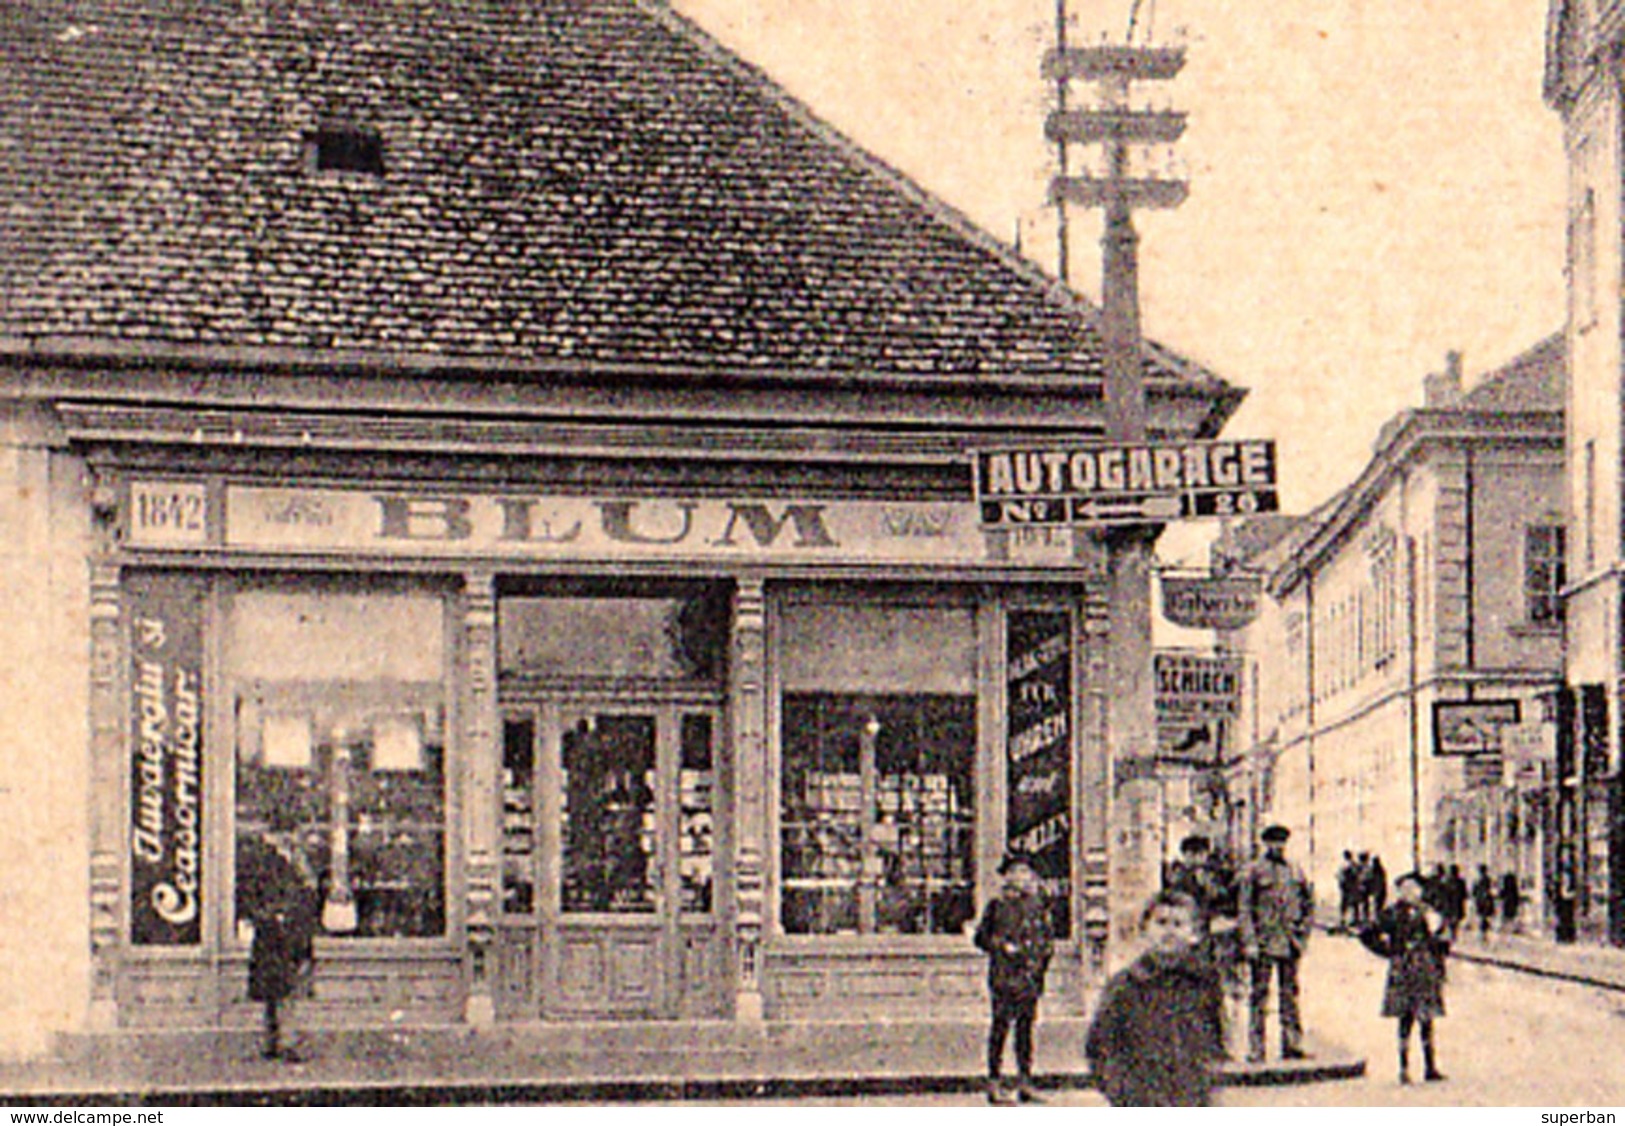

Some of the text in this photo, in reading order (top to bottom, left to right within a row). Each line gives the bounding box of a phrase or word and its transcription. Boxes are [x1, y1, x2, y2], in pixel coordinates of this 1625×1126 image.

[988, 441, 1270, 494] AUTOGARAGE
[138, 492, 202, 530] 1842
[374, 497, 841, 548] BLUM
